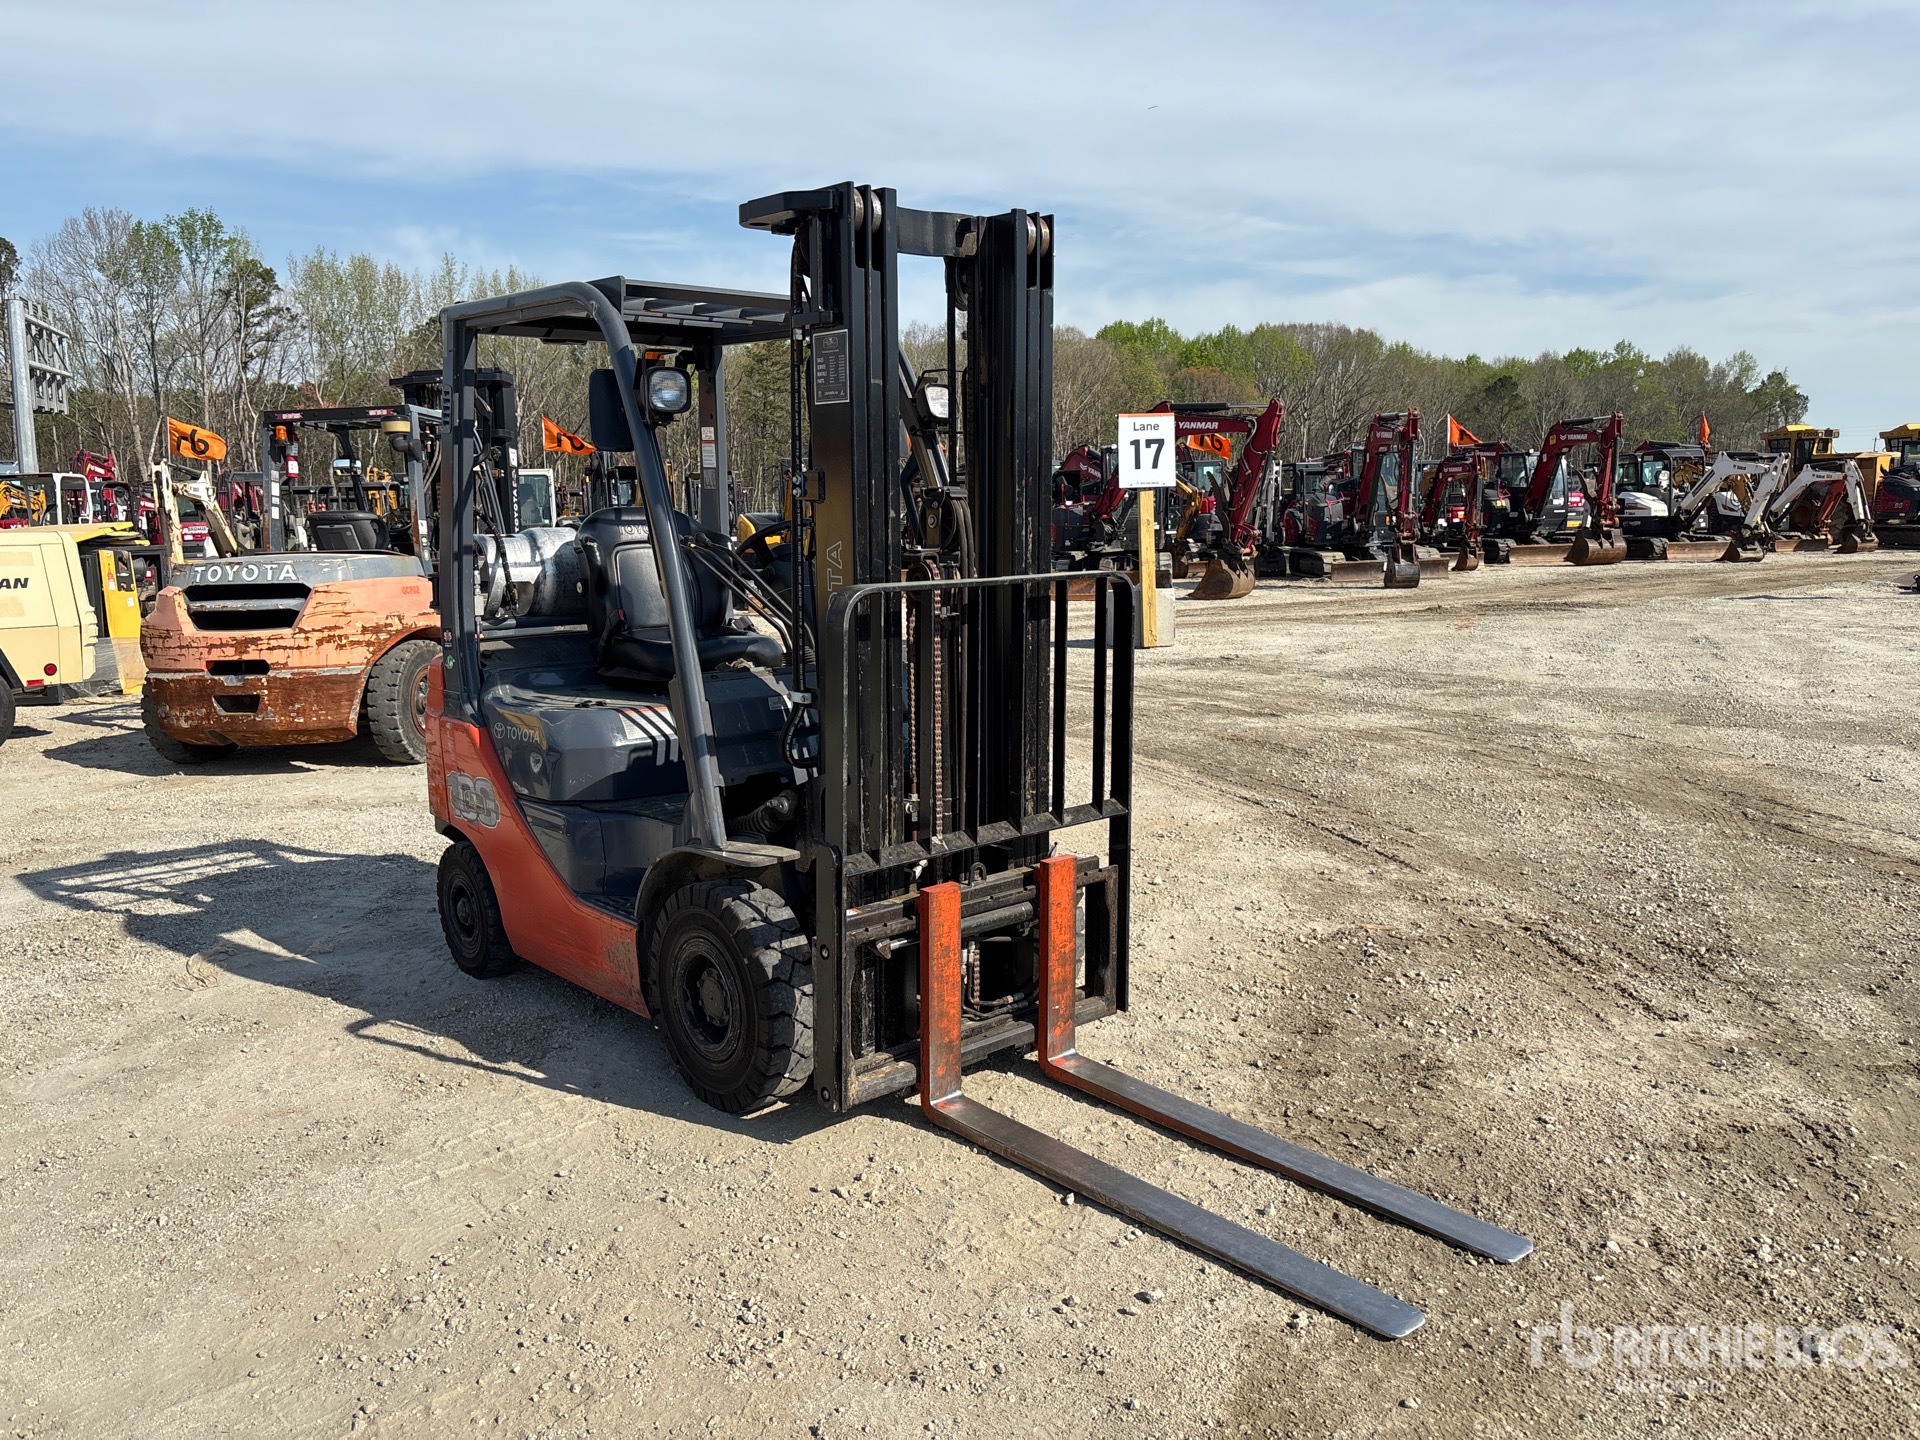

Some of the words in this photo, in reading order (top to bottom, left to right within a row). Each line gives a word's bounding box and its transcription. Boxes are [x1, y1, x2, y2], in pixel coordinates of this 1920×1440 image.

[1133, 421, 1160, 431] Lane
[1178, 421, 1219, 430] YANMAR
[1130, 438, 1165, 470] 17
[512, 489, 520, 533] TOYOTA
[618, 524, 650, 535] TOYO
[194, 564, 298, 583] TOYOTA
[506, 726, 541, 744] TOYOTA
